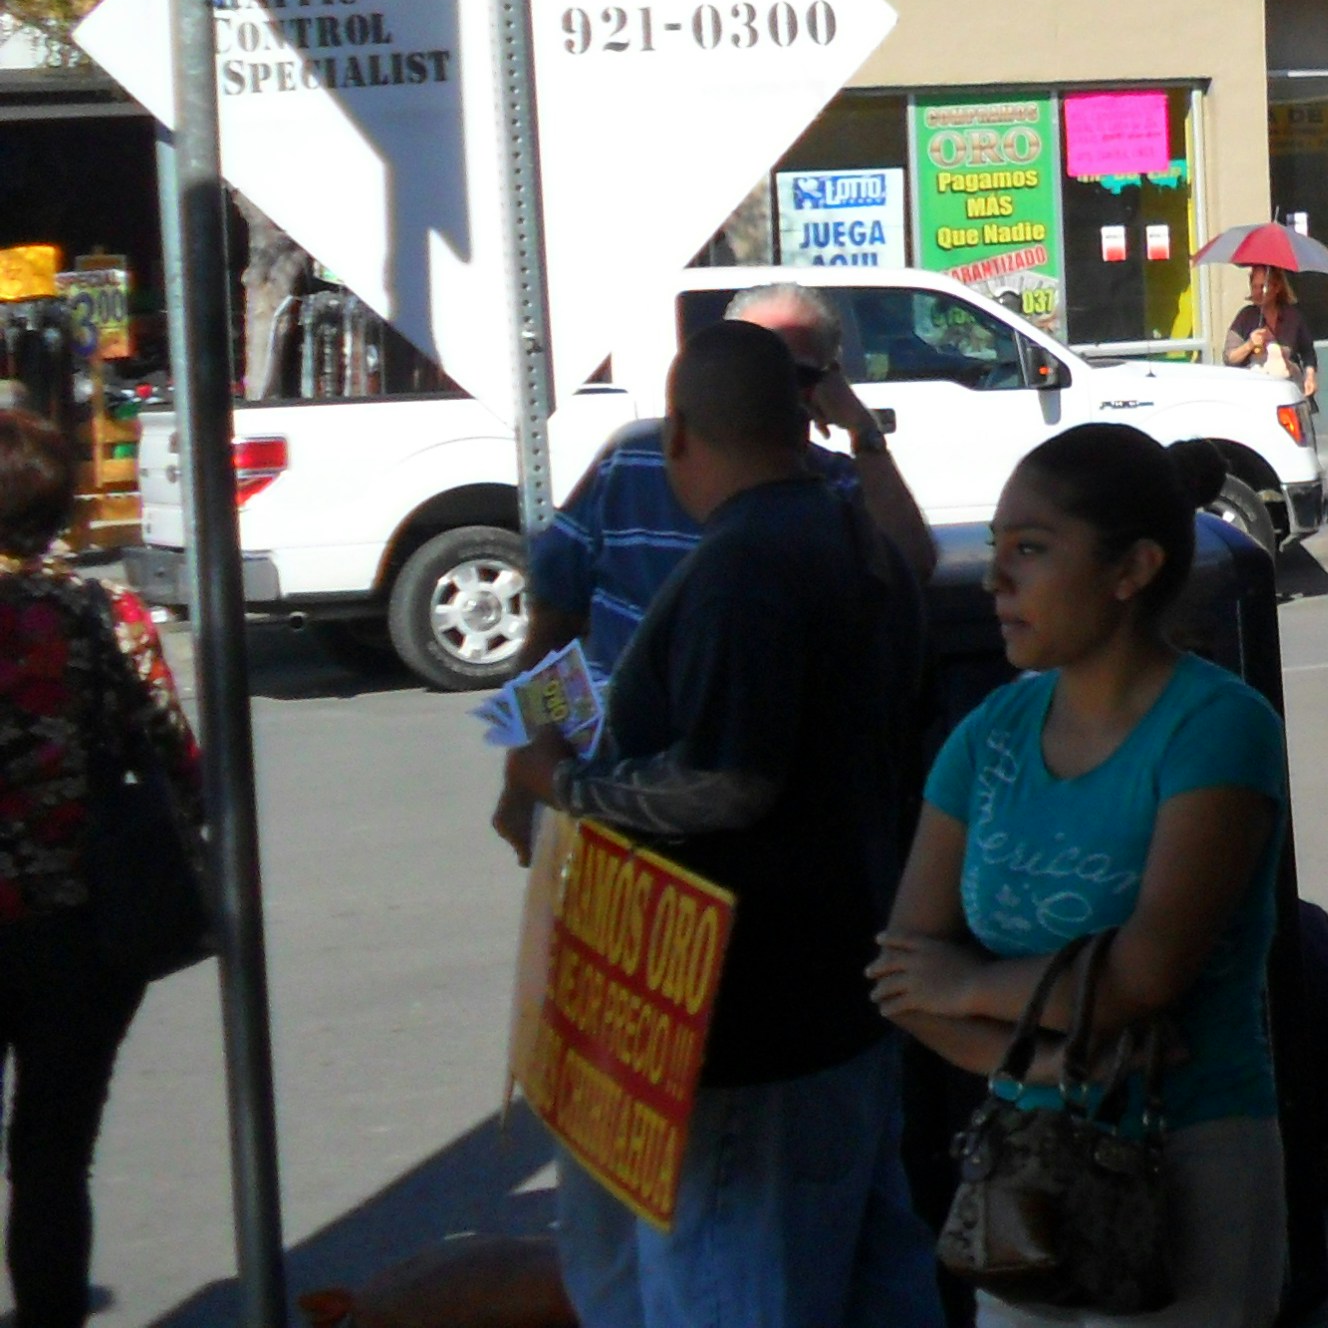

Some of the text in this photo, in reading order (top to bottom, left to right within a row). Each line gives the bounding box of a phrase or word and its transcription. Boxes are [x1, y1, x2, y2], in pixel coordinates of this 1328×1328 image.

[561, 0, 837, 55] 921-0300
[223, 51, 450, 96] SPECIALIST
[925, 103, 1040, 127] COMPRAMOS
[928, 126, 1042, 167] ORO
[826, 178, 882, 204] LOTTO
[936, 170, 1039, 194] Pagamos
[799, 220, 886, 249] JUEGA
[936, 222, 1046, 250] Que Nadie
[951, 246, 1048, 282] ARANTIZADO
[1022, 289, 1055, 315] 037
[648, 884, 719, 1016] ORO
[604, 987, 669, 1085] PRECIO
